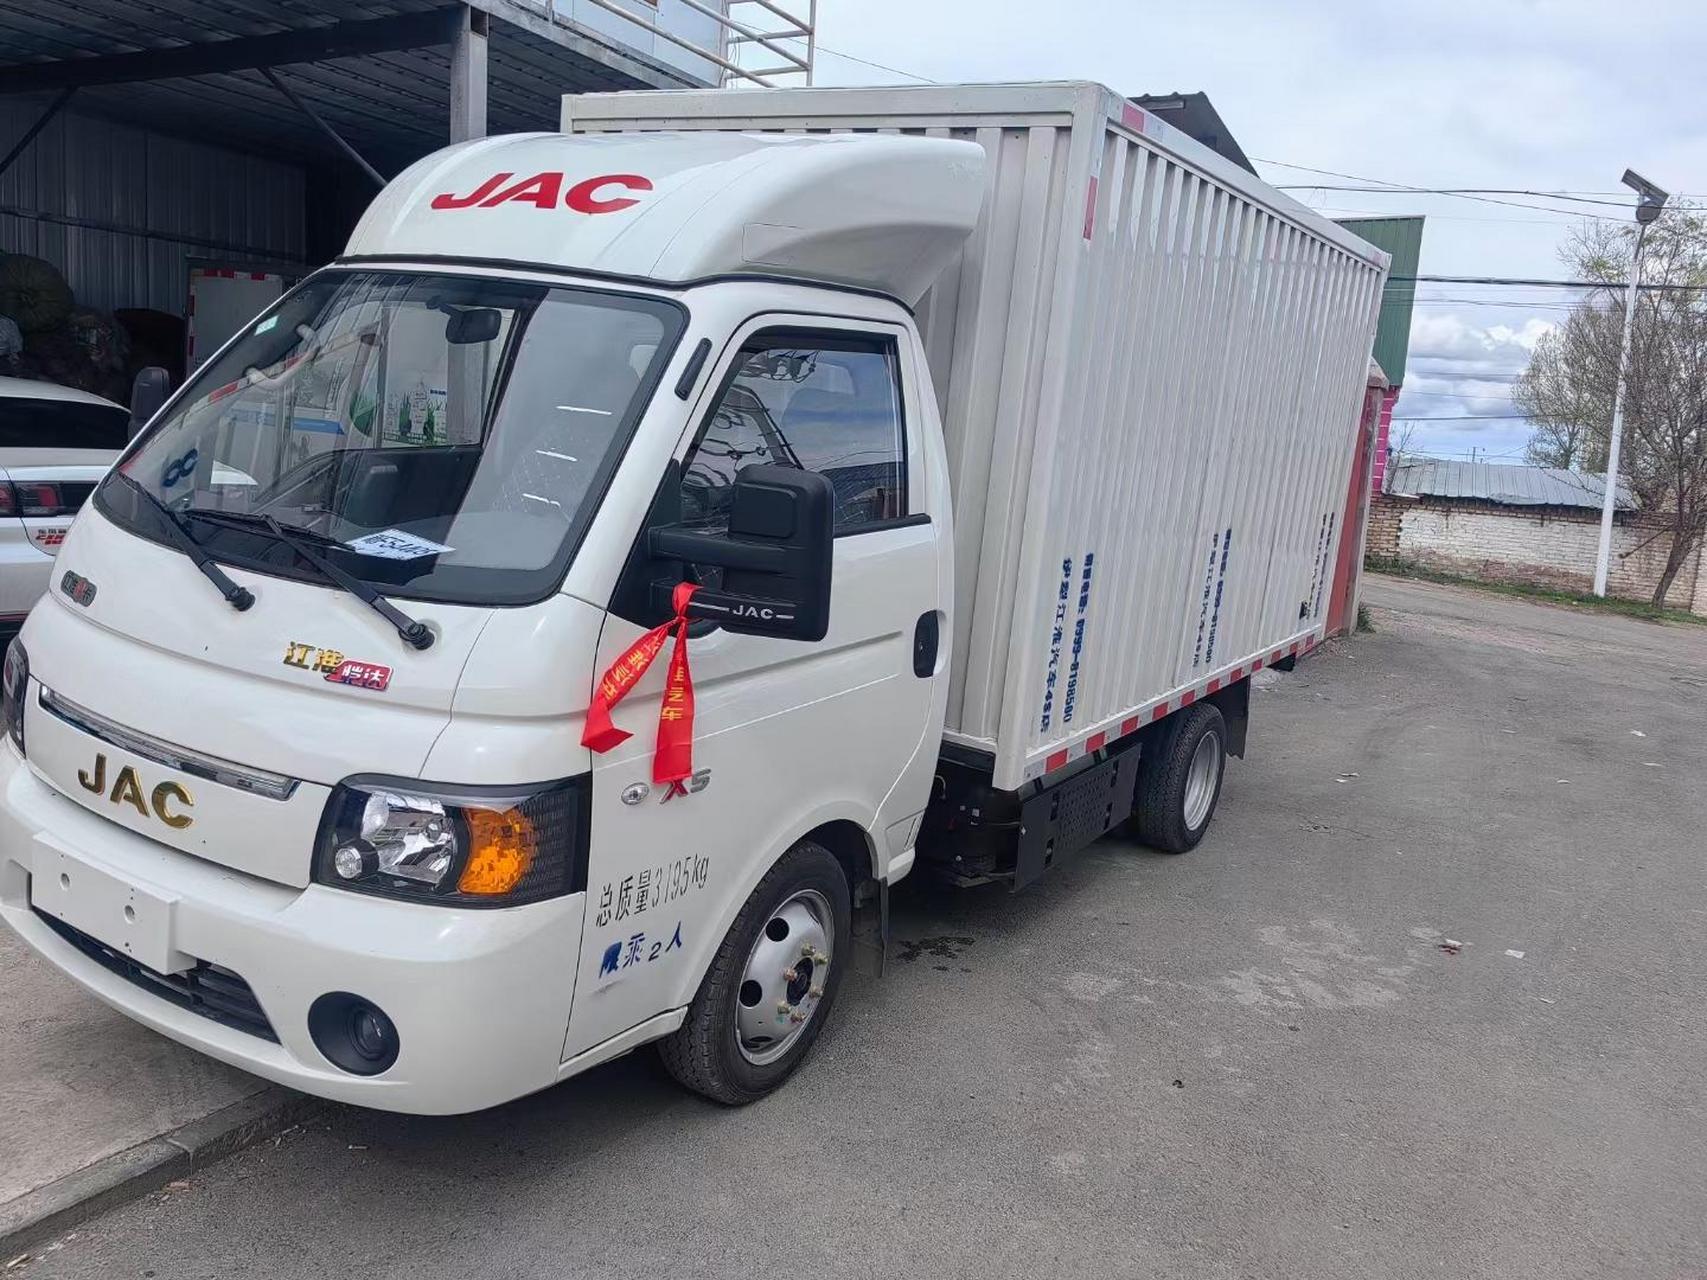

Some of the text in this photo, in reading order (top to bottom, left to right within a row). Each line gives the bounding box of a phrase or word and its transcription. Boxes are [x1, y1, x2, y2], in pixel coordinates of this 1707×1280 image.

[430, 171, 654, 215] JAC
[732, 605, 774, 620] JAC
[283, 641, 344, 674] 江淮
[77, 752, 196, 829] JAC
[595, 852, 710, 928] 总质量3195kg
